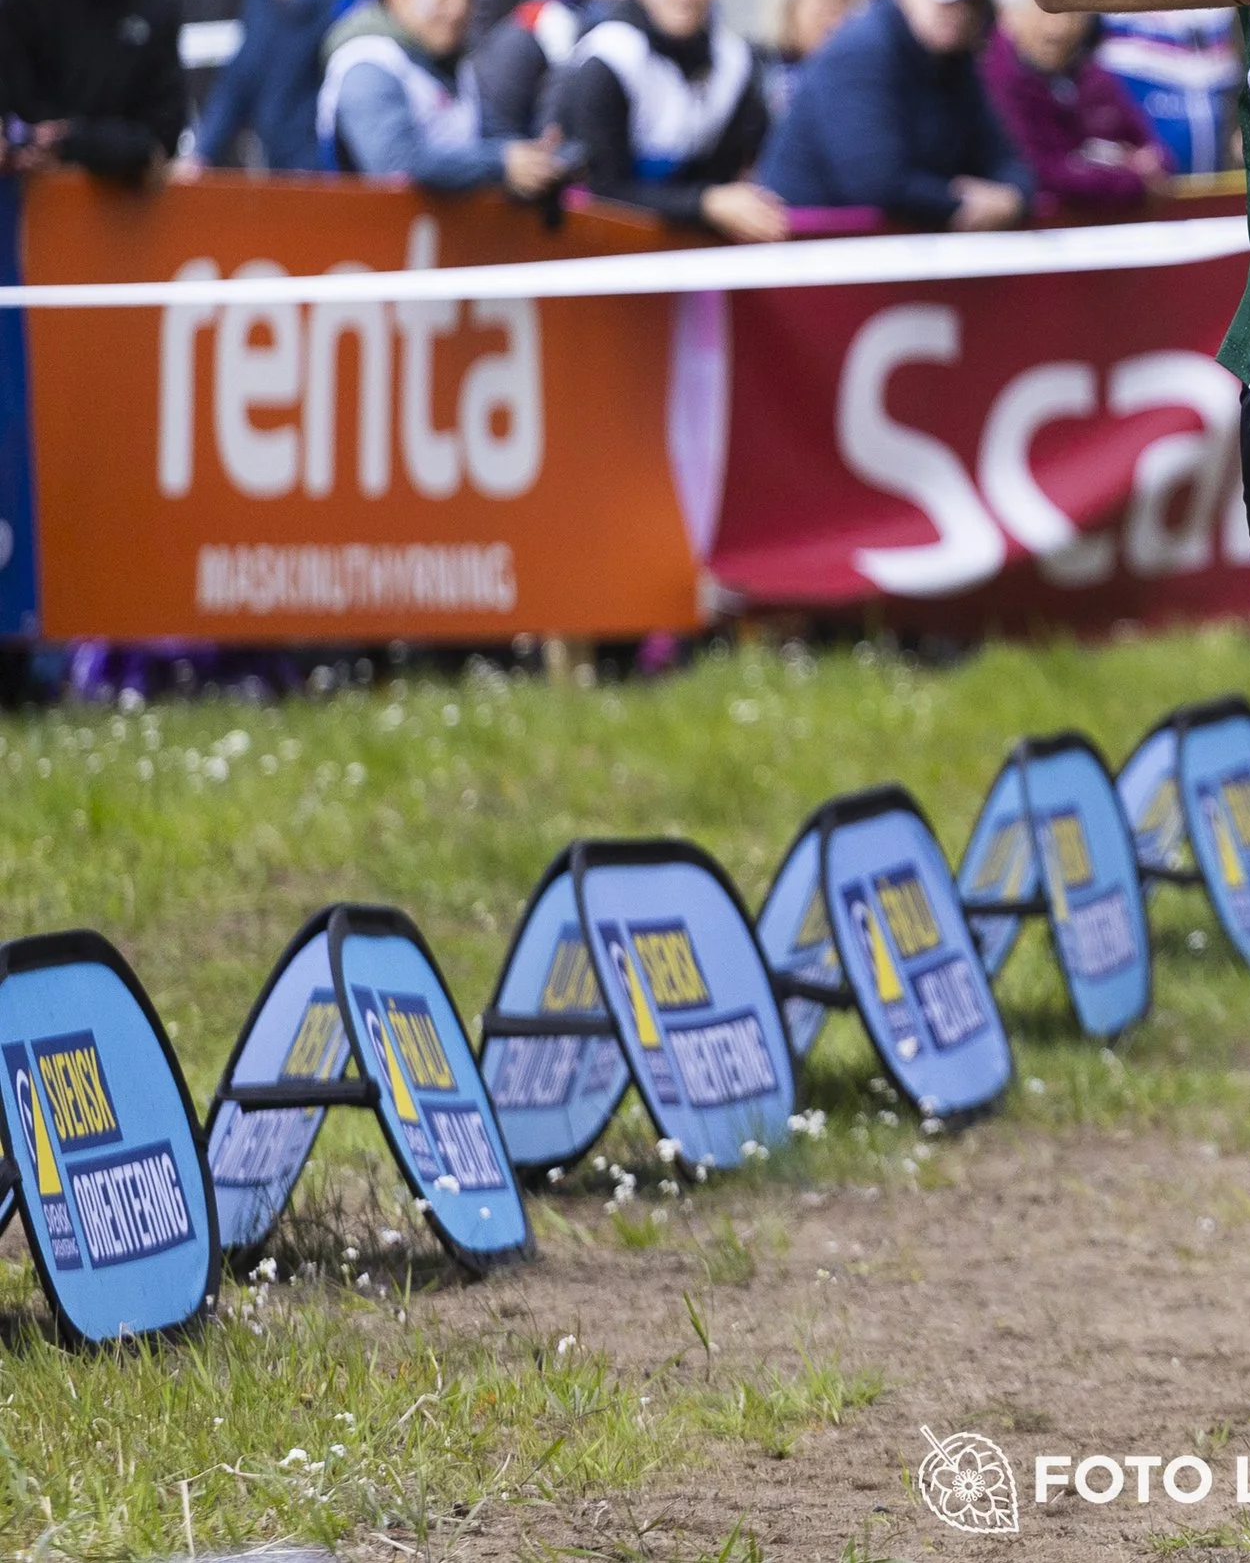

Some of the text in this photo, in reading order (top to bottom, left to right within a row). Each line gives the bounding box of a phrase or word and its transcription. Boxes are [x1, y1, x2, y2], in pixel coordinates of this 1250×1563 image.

[157, 215, 544, 500] renta
[39, 1046, 116, 1141] SVENSK
[73, 1152, 189, 1262] ORIENTERING
